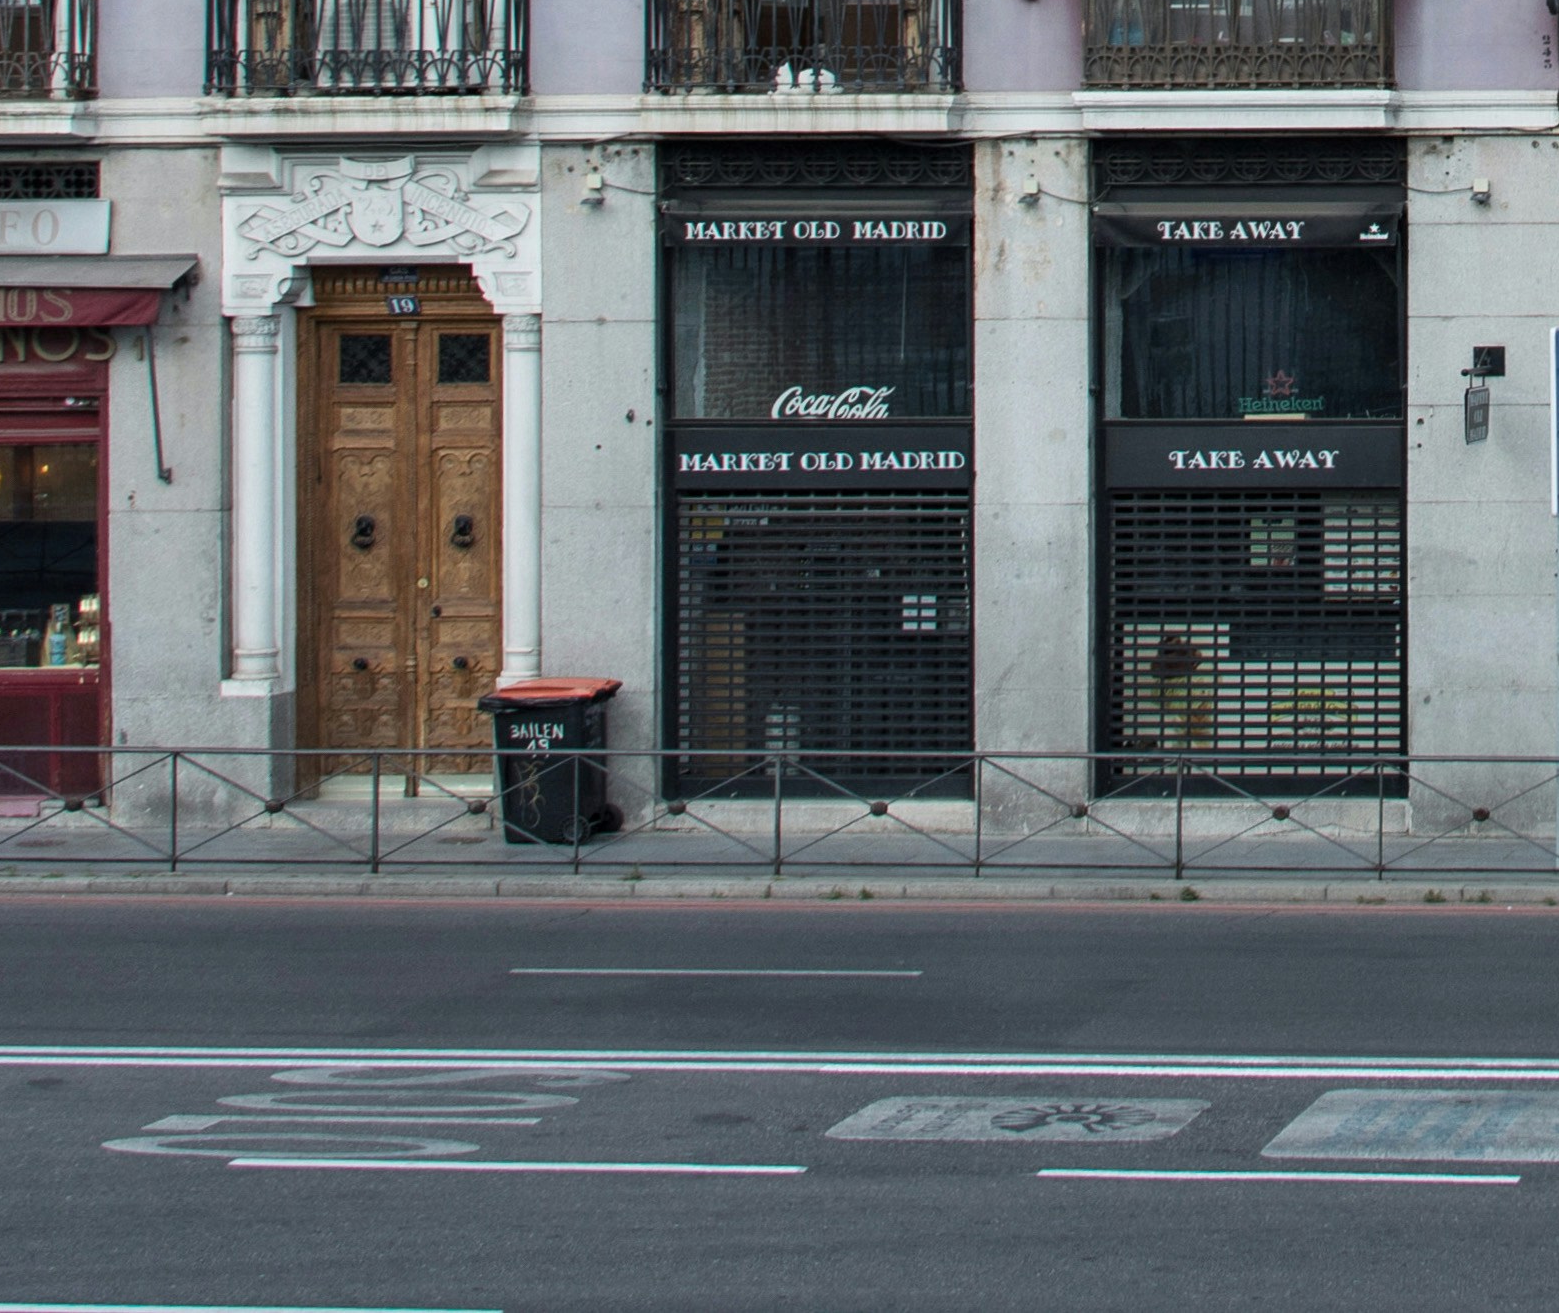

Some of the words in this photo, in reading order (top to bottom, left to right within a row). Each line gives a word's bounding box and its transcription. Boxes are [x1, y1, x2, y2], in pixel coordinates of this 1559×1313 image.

[685, 221, 787, 240] MARKET
[794, 221, 840, 240] OLD
[853, 220, 947, 240] MADRID
[1157, 221, 1224, 241] TAKE
[1229, 221, 1304, 241] AWAY
[391, 298, 415, 313] 19
[1238, 397, 1323, 413] Heineken
[679, 452, 794, 472] MARKET
[801, 452, 853, 471] OLD
[859, 451, 965, 470] MADRID
[1168, 450, 1245, 470] TAKE
[1253, 450, 1339, 469] AWAY
